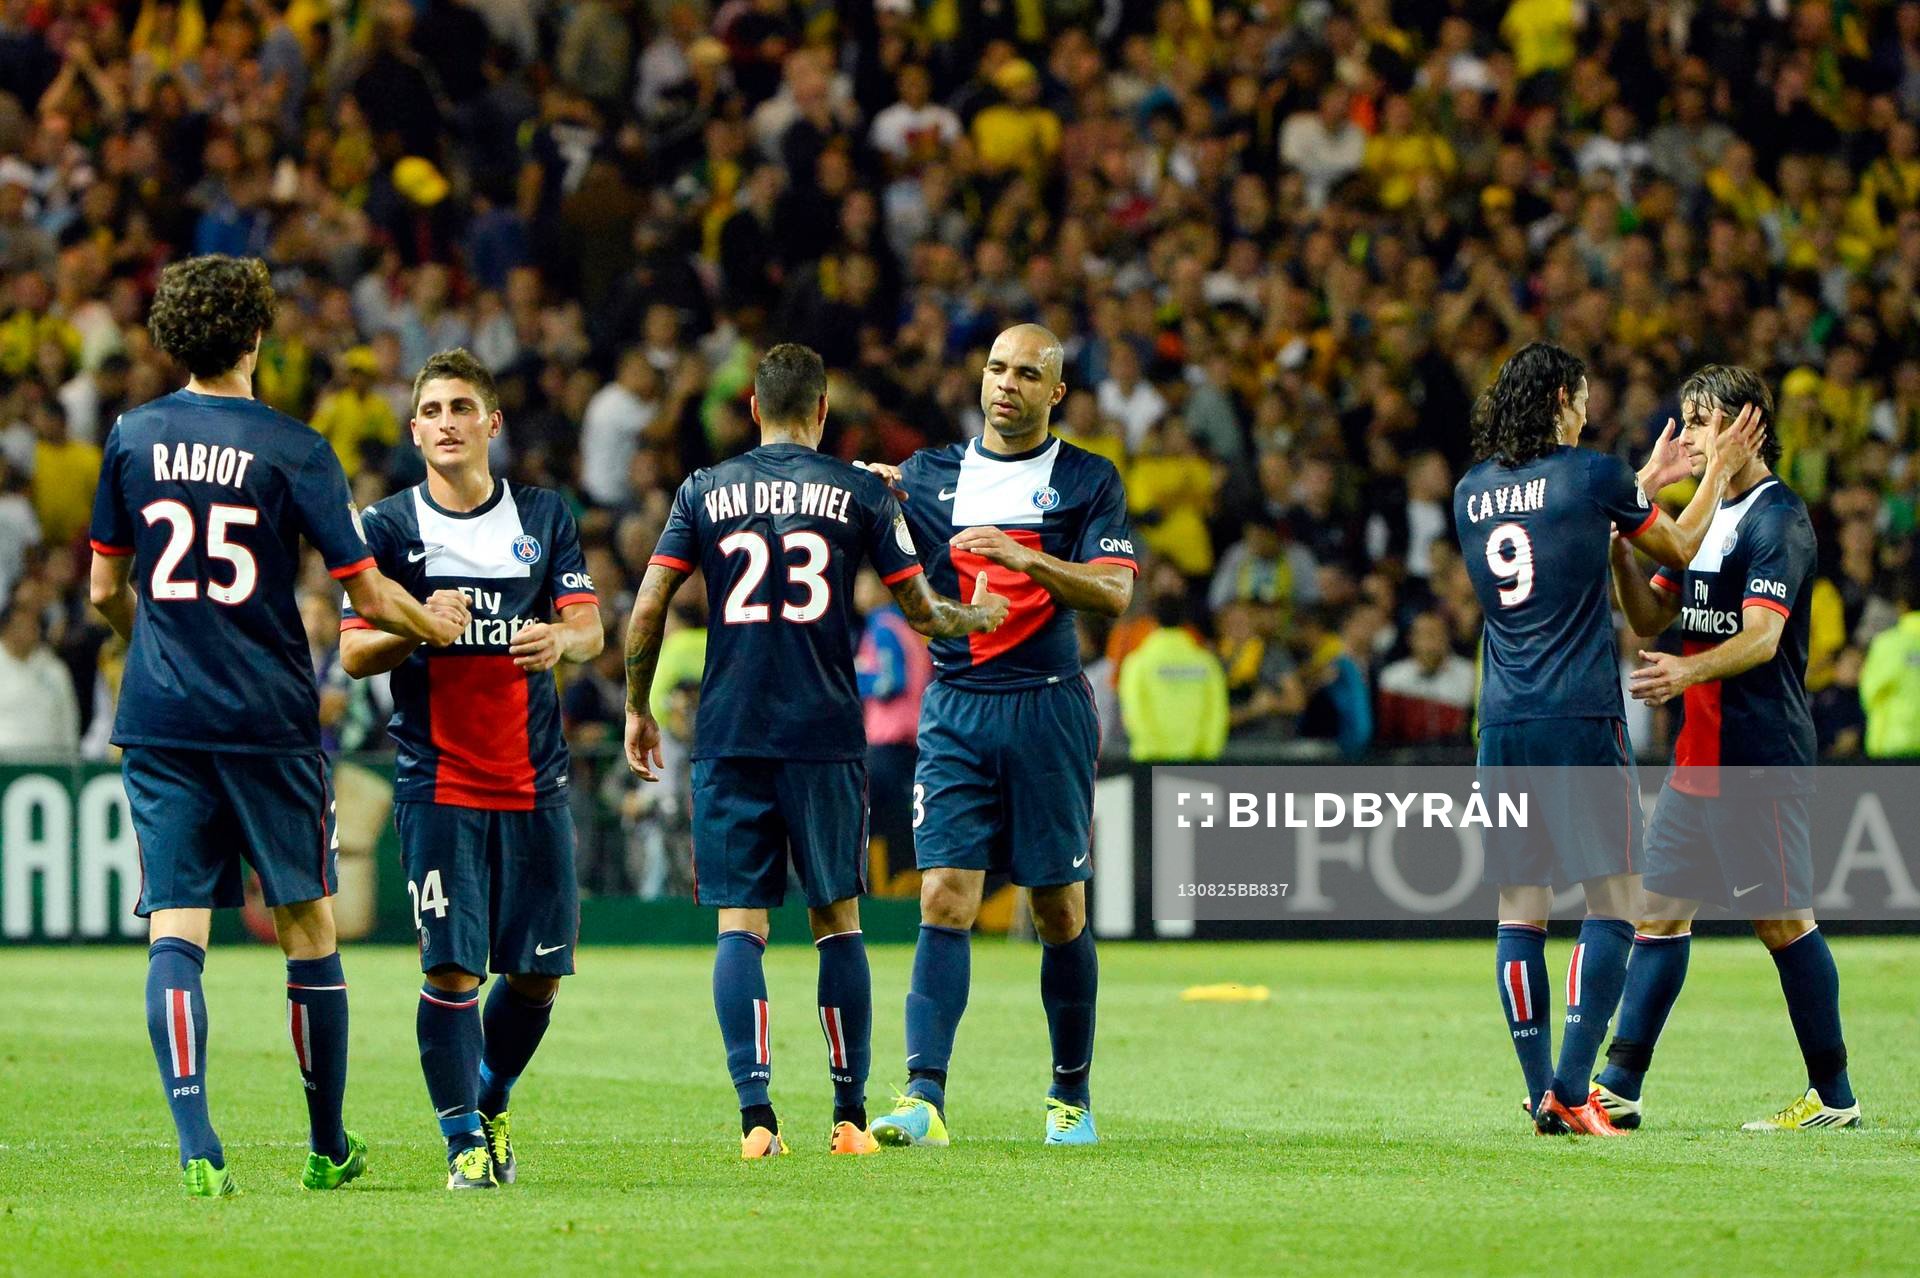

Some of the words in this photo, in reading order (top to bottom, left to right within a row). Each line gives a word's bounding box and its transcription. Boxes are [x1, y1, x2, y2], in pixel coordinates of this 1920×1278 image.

[152, 442, 255, 489] RABIOT
[704, 482, 748, 524] VAN
[754, 481, 798, 515] DER
[801, 481, 852, 524] WIEL
[1466, 478, 1546, 524] CAVANI
[140, 498, 259, 607] 25
[1100, 537, 1134, 555] QNB
[717, 529, 832, 626] 23
[1485, 522, 1535, 608] 9
[1694, 579, 1709, 605] Fly
[1750, 578, 1788, 599] QNB
[1681, 601, 1739, 635] mirates
[1513, 1027, 1538, 1039] PSG
[1565, 1013, 1581, 1024] SG
[173, 1085, 200, 1098] PSG
